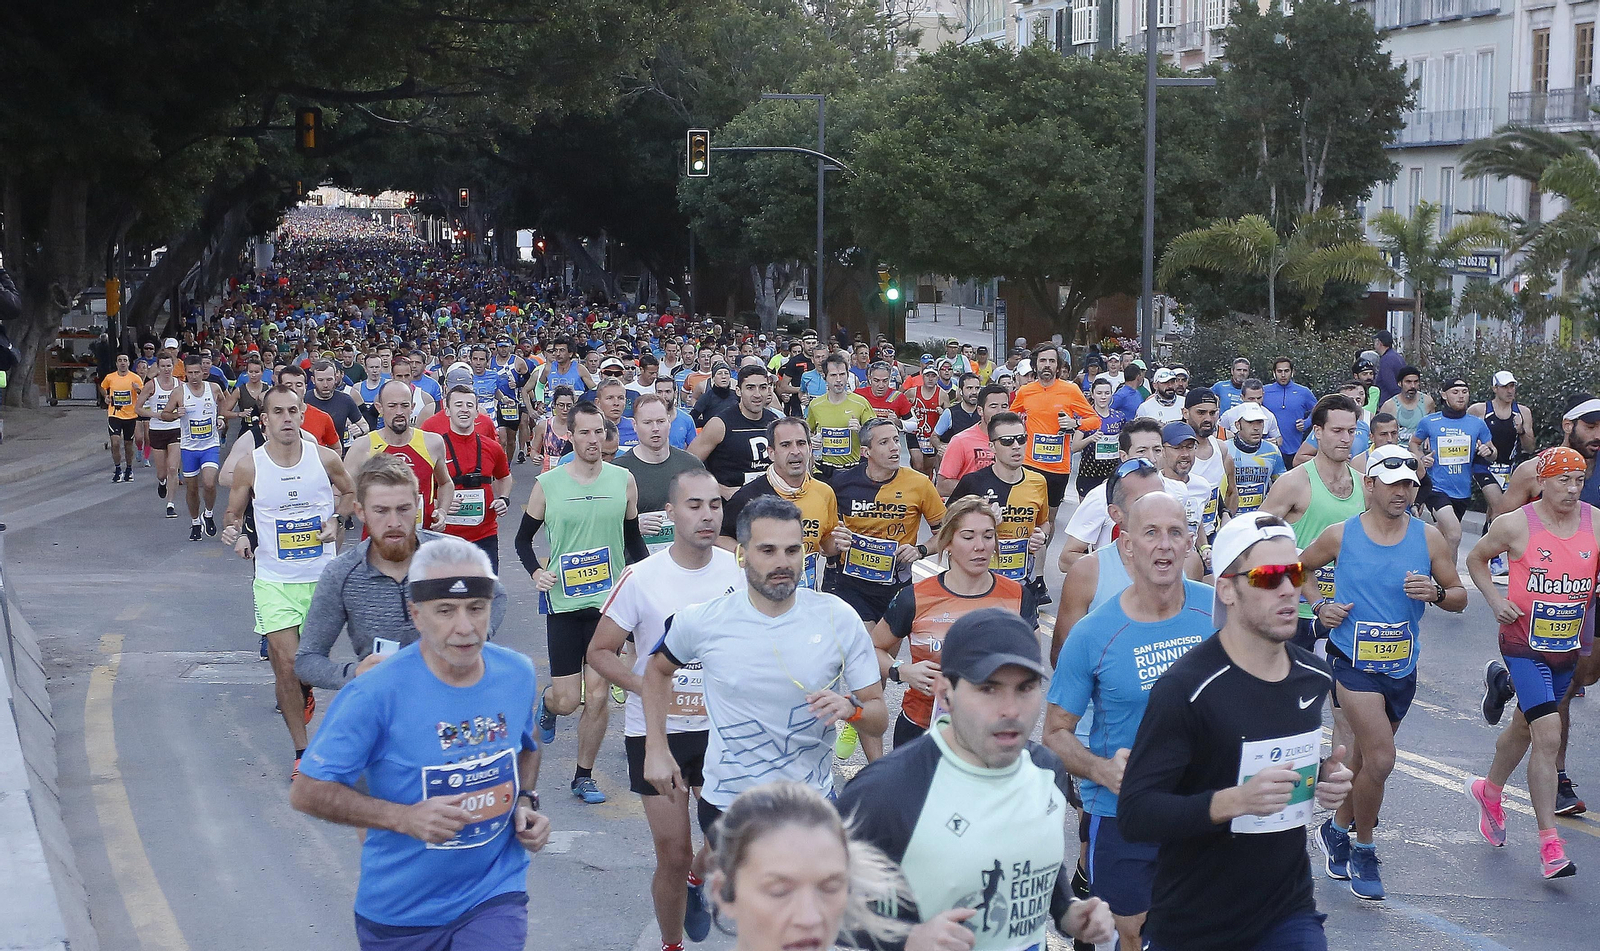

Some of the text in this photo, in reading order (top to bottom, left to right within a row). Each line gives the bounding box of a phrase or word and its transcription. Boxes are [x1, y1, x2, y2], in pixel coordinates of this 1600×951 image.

[1448, 465, 1462, 475] SUN
[851, 499, 907, 513] bichos
[851, 510, 906, 520] runners
[291, 533, 311, 542] 1259
[866, 542, 886, 551] ZURICH
[861, 553, 881, 564] 1158
[577, 567, 598, 578] 1135
[1317, 583, 1333, 592] 973
[1526, 572, 1593, 595] Alcabozo
[1556, 608, 1578, 616] ZURICH
[1549, 622, 1572, 632] 1397
[1133, 634, 1202, 656] SAN FRANCISCO
[1374, 644, 1398, 654] 1347
[676, 694, 706, 707] 6141
[436, 713, 508, 750] RUN
[1285, 744, 1314, 757] ZURICH
[465, 767, 500, 783] ZURICH
[1012, 860, 1031, 880] 54
